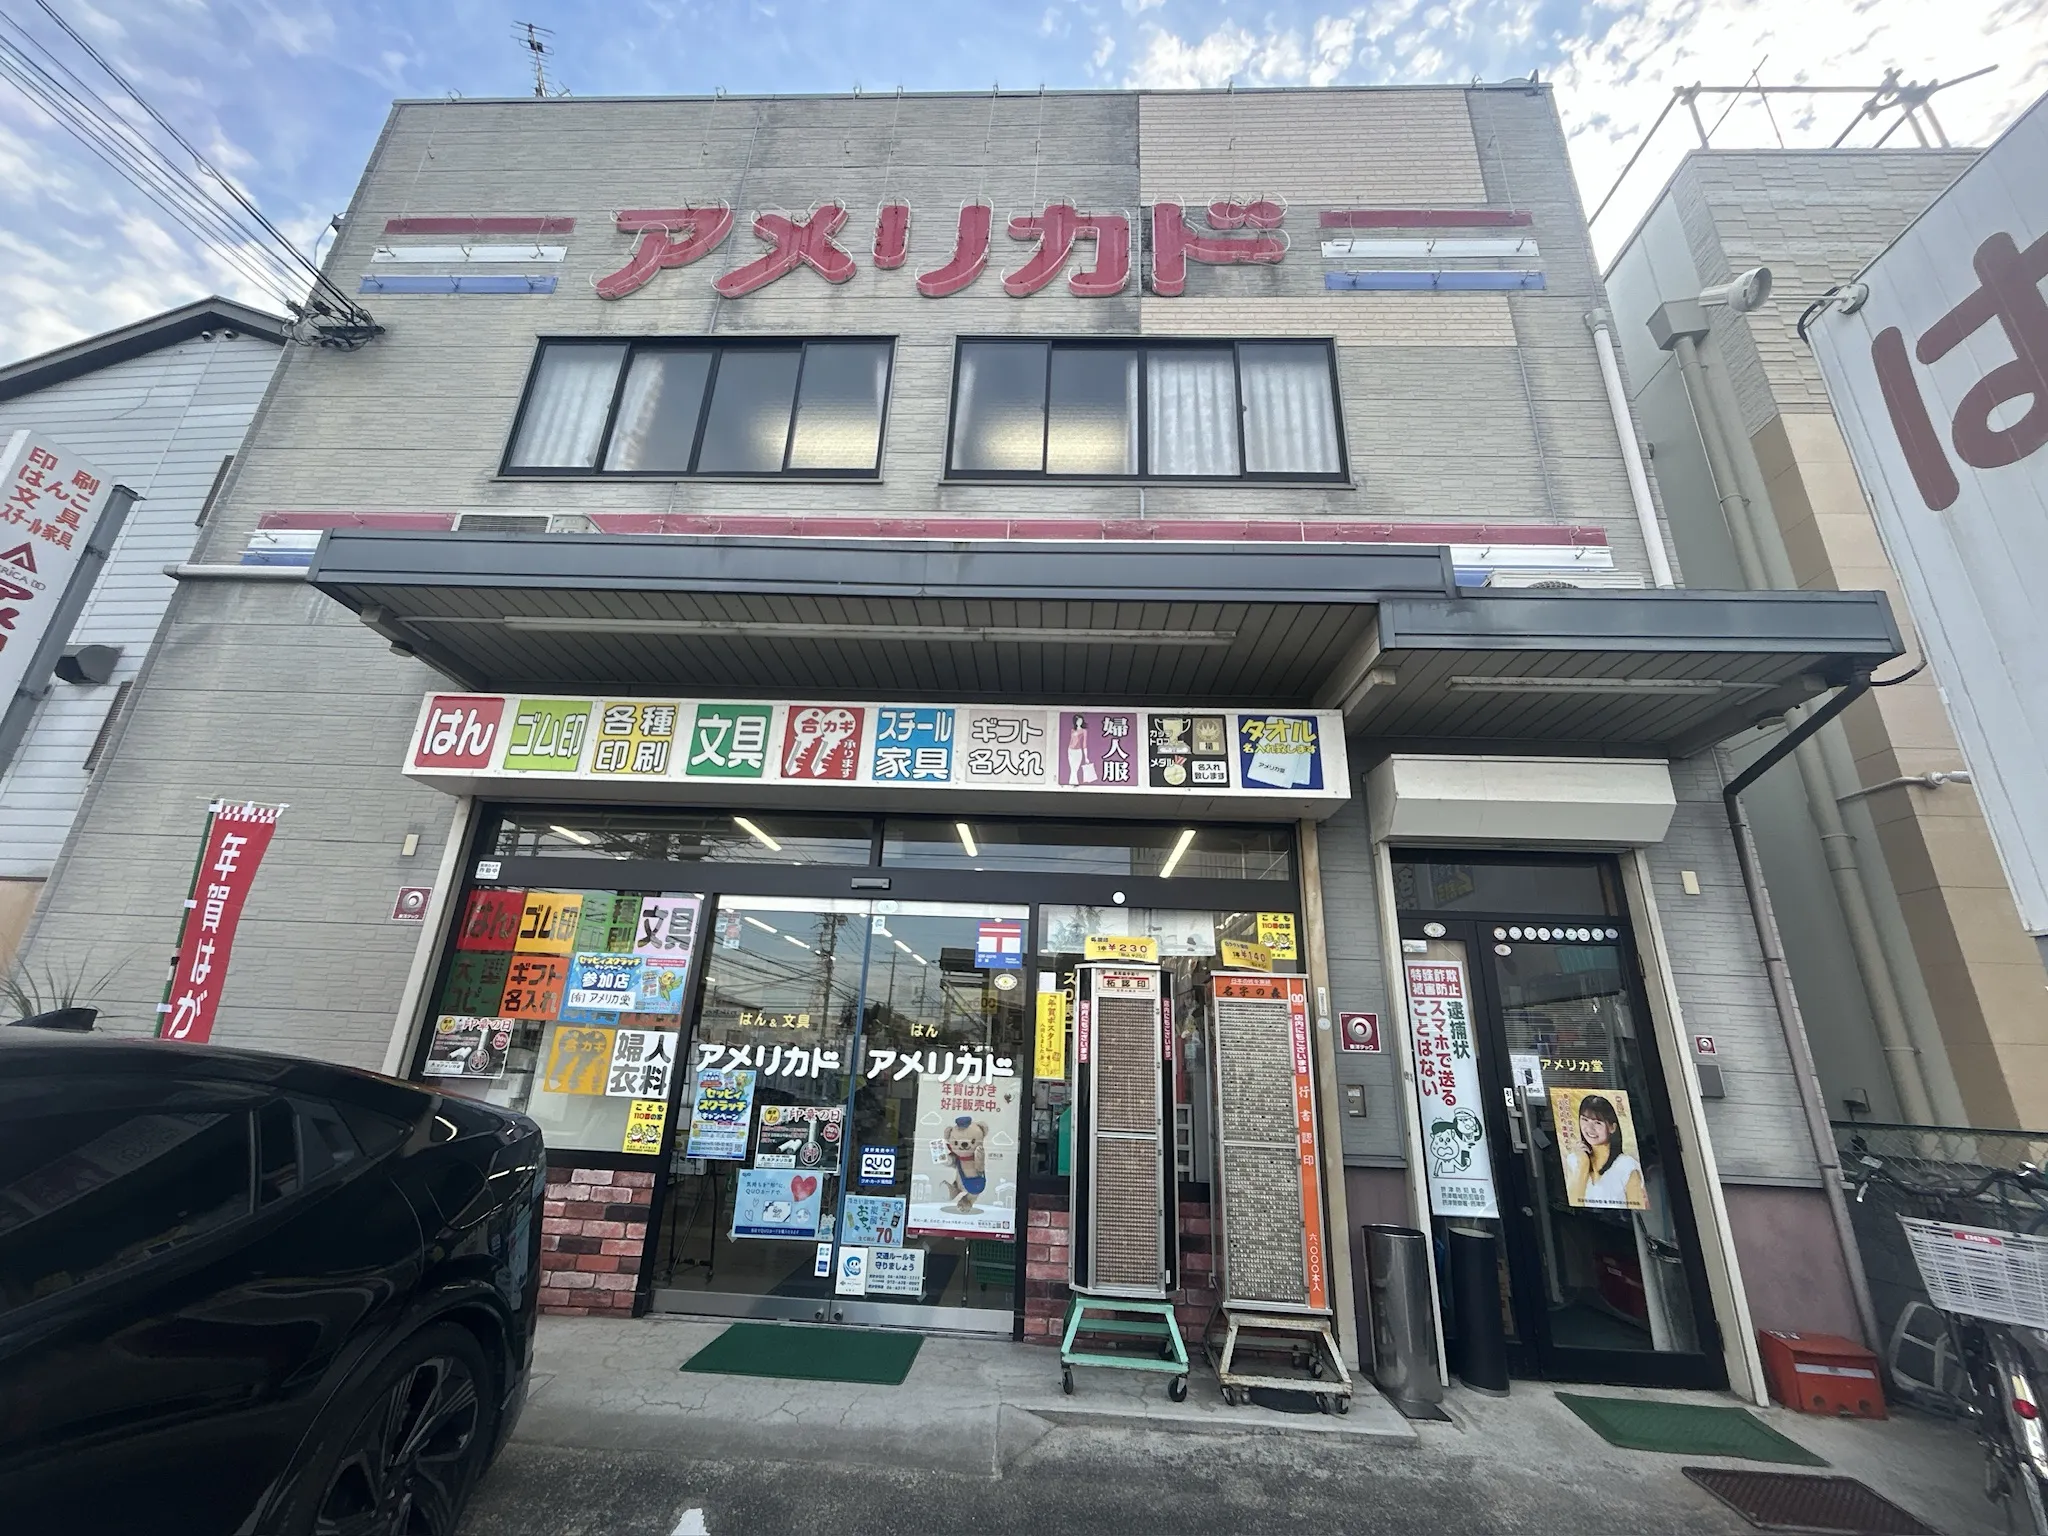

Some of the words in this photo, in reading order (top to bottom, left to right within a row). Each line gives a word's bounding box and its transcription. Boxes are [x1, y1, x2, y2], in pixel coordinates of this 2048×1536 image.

[596, 200, 1286, 301] アメリカド
[27, 446, 101, 496] 印刷
[17, 464, 90, 514] はんこ
[9, 485, 81, 532] 文具
[422, 707, 494, 757] はん
[603, 704, 675, 737] 各種
[800, 711, 855, 735] 合カギ
[879, 709, 952, 741] スチール
[971, 718, 1044, 745] ギフト
[1241, 719, 1317, 743] タオル
[509, 713, 587, 758] ゴム印
[690, 713, 763, 769] 文具
[595, 739, 669, 773] 印刷
[841, 739, 857, 778] 承ります
[1102, 716, 1130, 783] 婦人服
[1242, 744, 1317, 755] 名入れ致します
[876, 746, 949, 780] 家具
[967, 749, 1044, 776] 名入れ
[1150, 757, 1174, 767] メダル
[1197, 763, 1221, 772] 名入れ
[1194, 772, 1226, 781] 致します
[467, 901, 517, 940] はん
[520, 904, 580, 941] ゴム印
[637, 905, 696, 951] 文具
[1262, 914, 1291, 922] こども
[1108, 944, 1148, 953] ¥230
[1240, 950, 1266, 962] ¥140
[510, 963, 563, 986] ギフト
[582, 972, 631, 990] 参加店
[1410, 968, 1458, 983] 特殊詐欺
[503, 989, 557, 1014] 名入れ
[589, 993, 631, 1006] アメリカ堂
[1222, 985, 1281, 998] 名字の森
[1412, 983, 1461, 996] 被害防止
[739, 1013, 767, 1027] はん
[769, 1018, 778, 1028] &
[782, 1014, 811, 1029] 文具
[911, 1023, 939, 1038] はん
[1447, 1001, 1471, 1060] 逮捕状
[615, 1032, 671, 1064] 婦人
[1413, 1000, 1439, 1097] ことはない
[1430, 1000, 1457, 1106] スマホで送る
[696, 1044, 840, 1079] アメリカド
[867, 1050, 1015, 1084] アメリカド
[1540, 1059, 1605, 1073] アメリカ堂
[610, 1063, 667, 1096] 衣料
[942, 1083, 998, 1098] 年賀はがき
[635, 1103, 665, 1112] こども
[699, 1100, 747, 1112] スクラッチ
[940, 1098, 1002, 1113] 好評販売中。
[1505, 1089, 1513, 1104] 引く
[701, 1112, 739, 1120] キャンペーン
[788, 1108, 842, 1121] 印章の日
[1298, 1085, 1314, 1166] 行書認印
[864, 1157, 892, 1170] QUO
[876, 1227, 893, 1244] 70
[875, 1252, 916, 1261] 交通ルールを
[875, 1261, 915, 1272] 守りましょう
